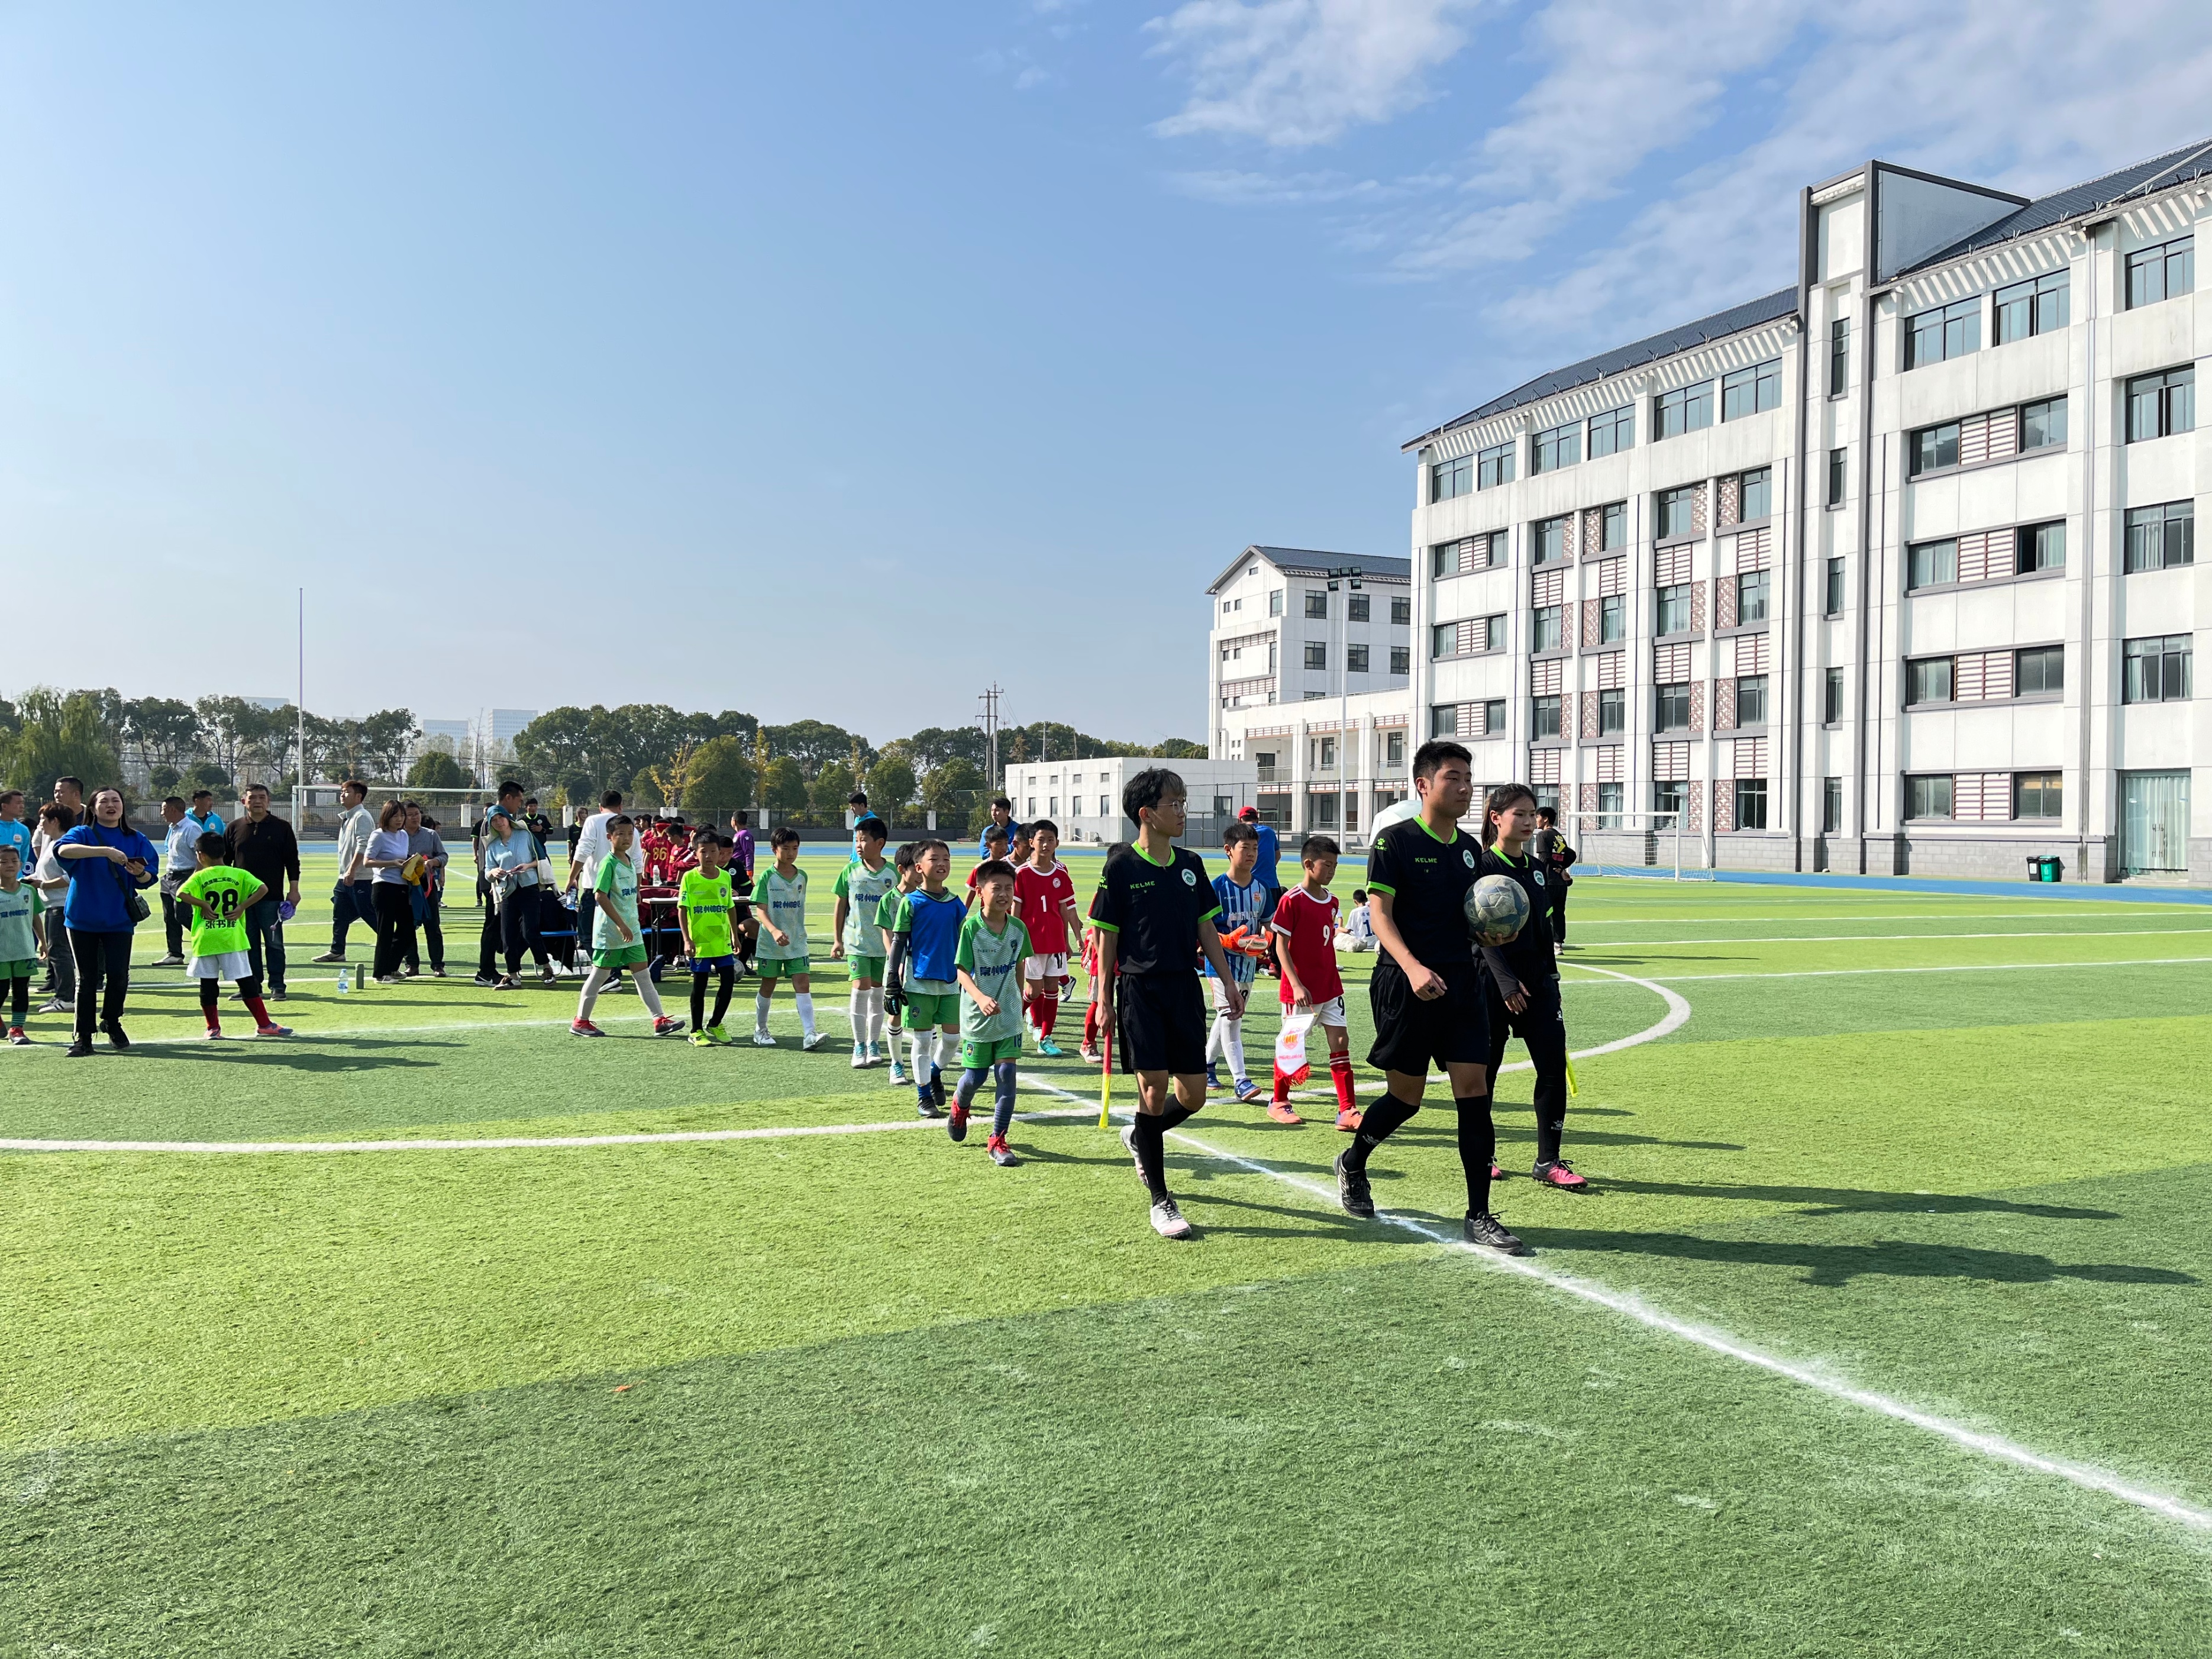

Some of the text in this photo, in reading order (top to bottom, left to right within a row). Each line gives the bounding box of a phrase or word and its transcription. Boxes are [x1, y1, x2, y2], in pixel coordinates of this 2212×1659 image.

[653, 847, 667, 861] 86
[1130, 880, 1155, 889] KELME
[204, 888, 238, 919] 28
[1041, 895, 1047, 912] 1
[1323, 925, 1331, 947] 9
[1337, 995, 1345, 1016] 9
[1013, 1033, 1022, 1048] 18
